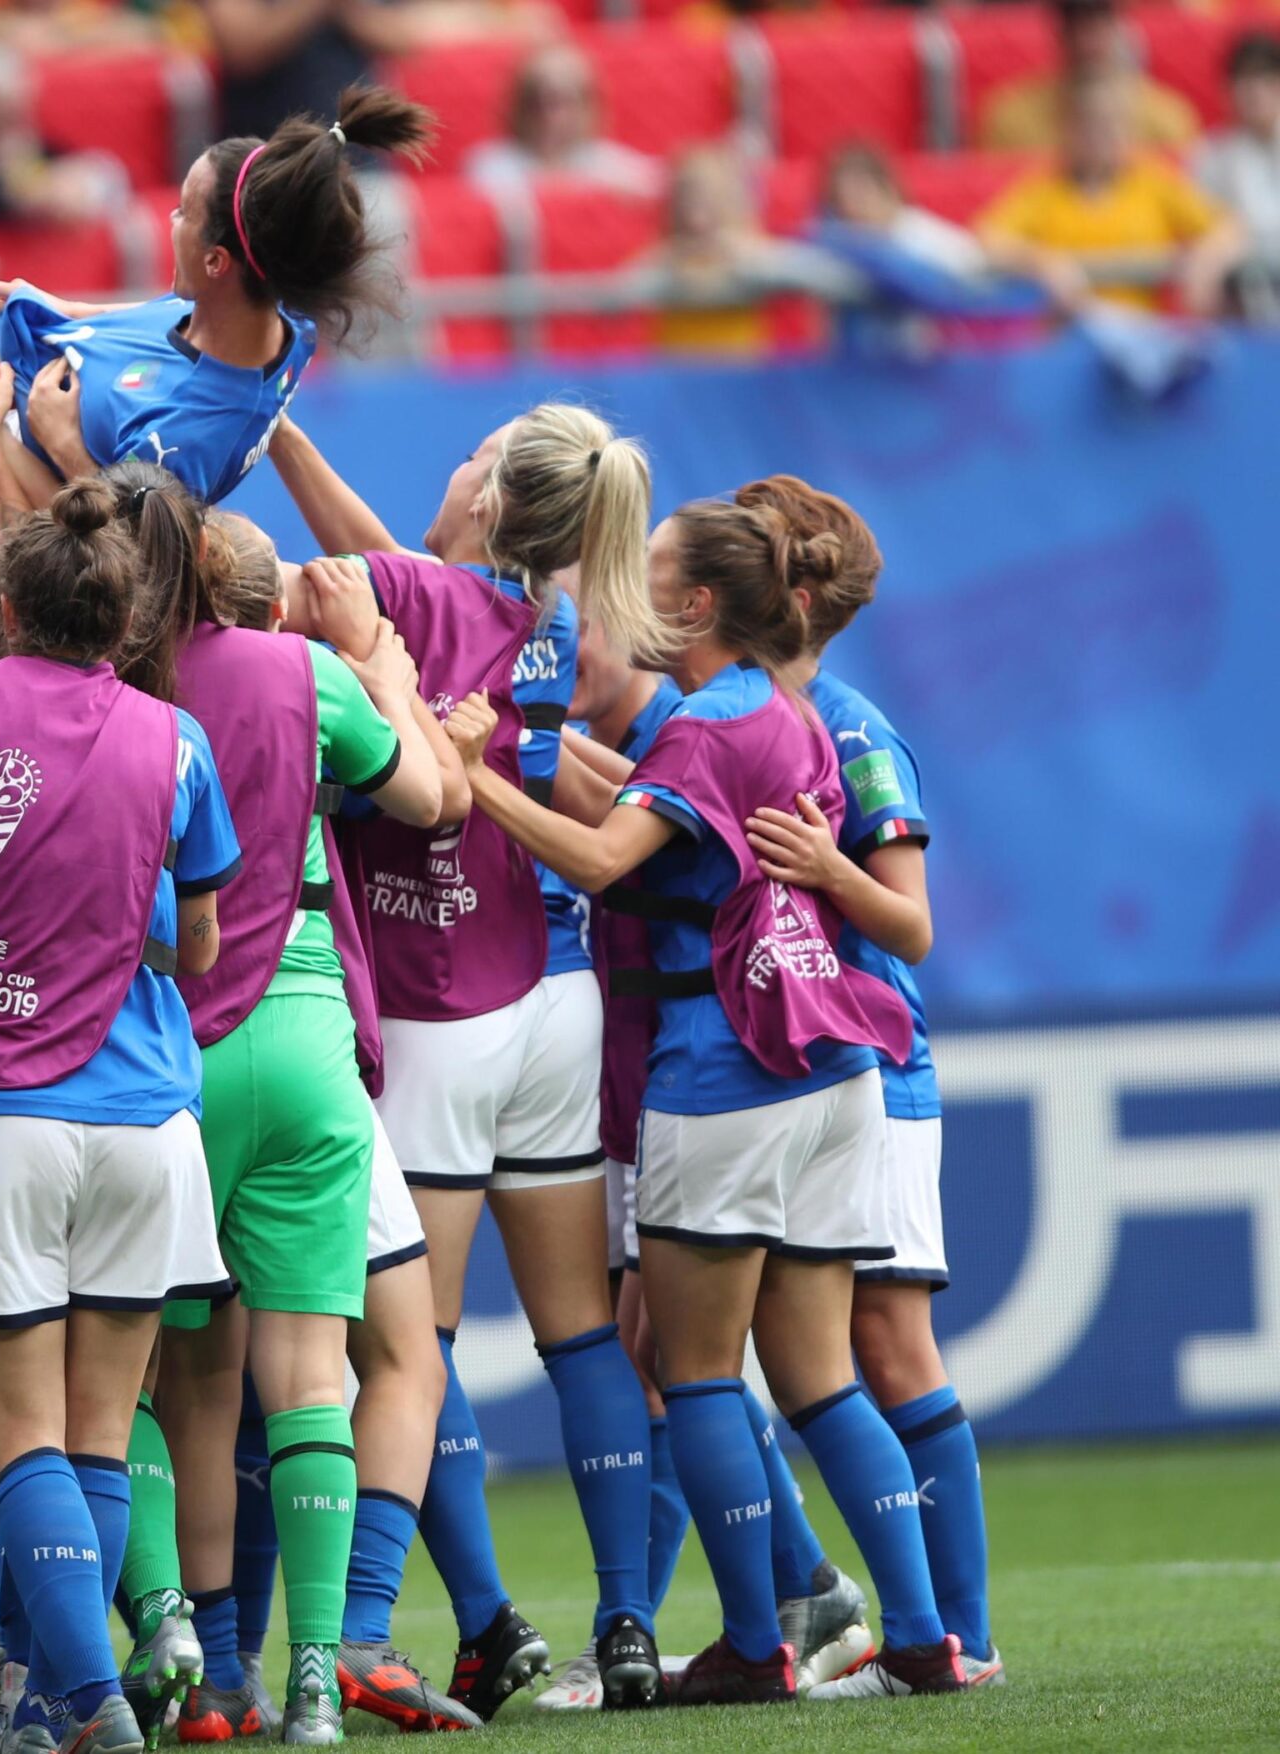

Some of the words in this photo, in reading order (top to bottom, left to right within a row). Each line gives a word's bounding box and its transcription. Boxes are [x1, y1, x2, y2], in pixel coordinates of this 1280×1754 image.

[427, 858, 454, 876] IFA
[775, 914, 799, 931] IFA
[7, 974, 35, 989] CUP
[437, 1437, 480, 1456] ALIA
[582, 1450, 643, 1473] ITALIA
[291, 1495, 349, 1513] ITALIA
[31, 1546, 98, 1562] ITALIA
[612, 1644, 645, 1655] COPA
